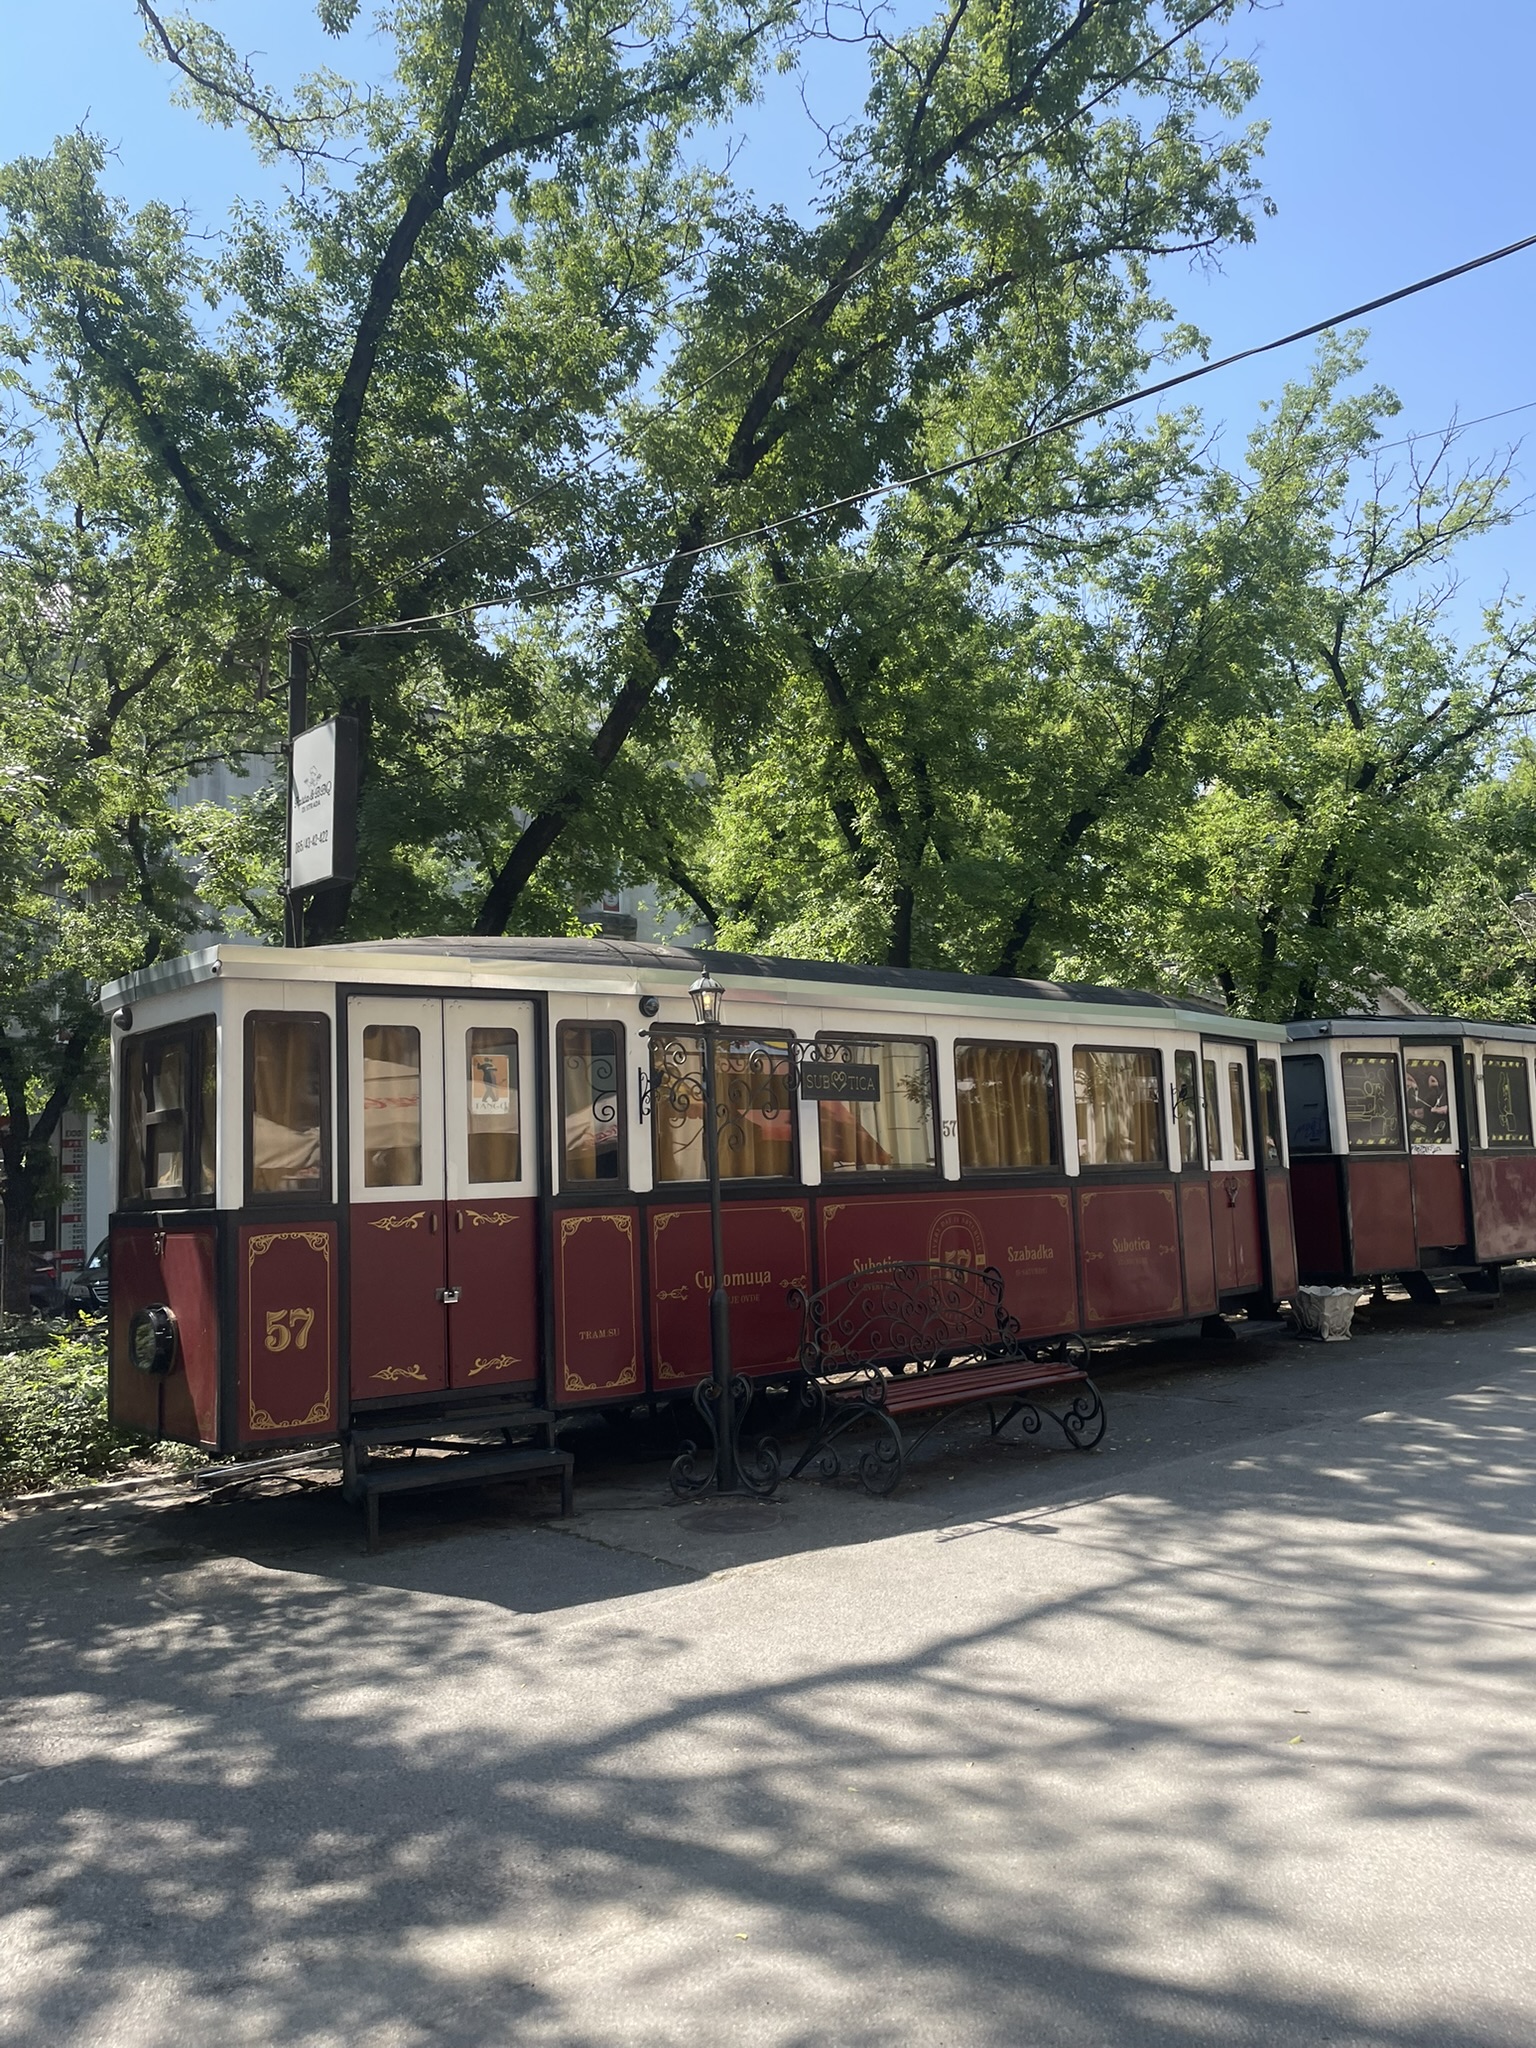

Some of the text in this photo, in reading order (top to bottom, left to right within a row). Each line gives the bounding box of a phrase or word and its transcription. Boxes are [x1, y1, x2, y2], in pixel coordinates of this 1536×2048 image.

[943, 1120, 957, 1137] 57
[153, 1231, 167, 1256] 57
[1007, 1243, 1054, 1262] Szabadka
[1112, 1236, 1151, 1253] Subotica
[695, 1270, 772, 1293] Суотица
[264, 1307, 315, 1352] 57
